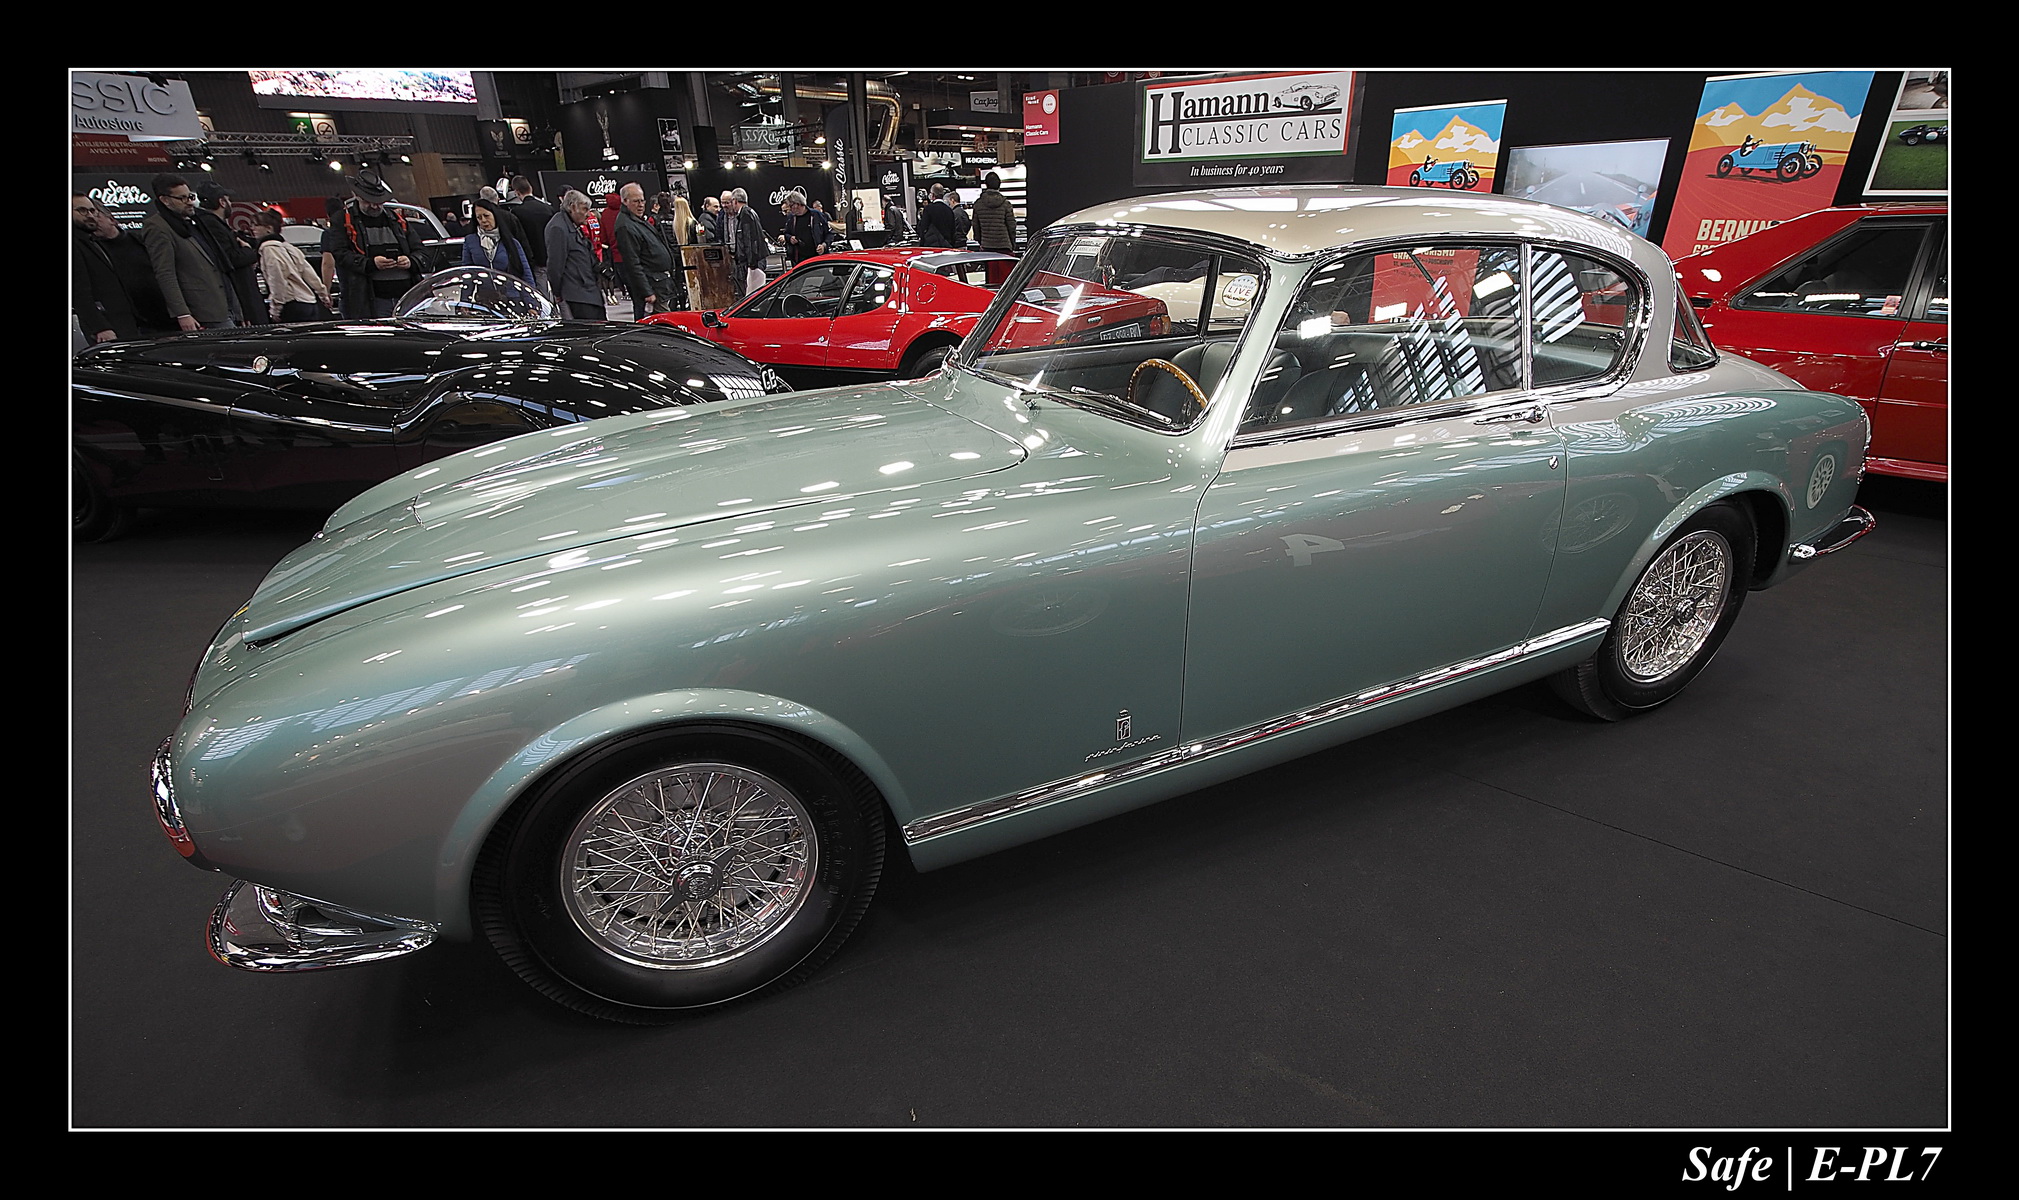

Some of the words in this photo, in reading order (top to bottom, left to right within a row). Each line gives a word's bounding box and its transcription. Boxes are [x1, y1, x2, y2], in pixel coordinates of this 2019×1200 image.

[75, 114, 144, 131] Autostore
[1148, 91, 1270, 154] Hamann
[1182, 123, 1269, 147] CLASSIC
[1281, 118, 1341, 142] CARS
[834, 138, 847, 184] Classic
[1190, 166, 1199, 176] In
[1200, 164, 1233, 176] business
[1233, 163, 1248, 177] for
[1248, 166, 1259, 176] 40
[1259, 164, 1285, 176] years
[88, 188, 152, 208] Classic
[107, 180, 140, 197] Saga
[1696, 219, 1775, 242] BERNI
[1227, 286, 1252, 296] LIVE
[761, 368, 777, 391] GB
